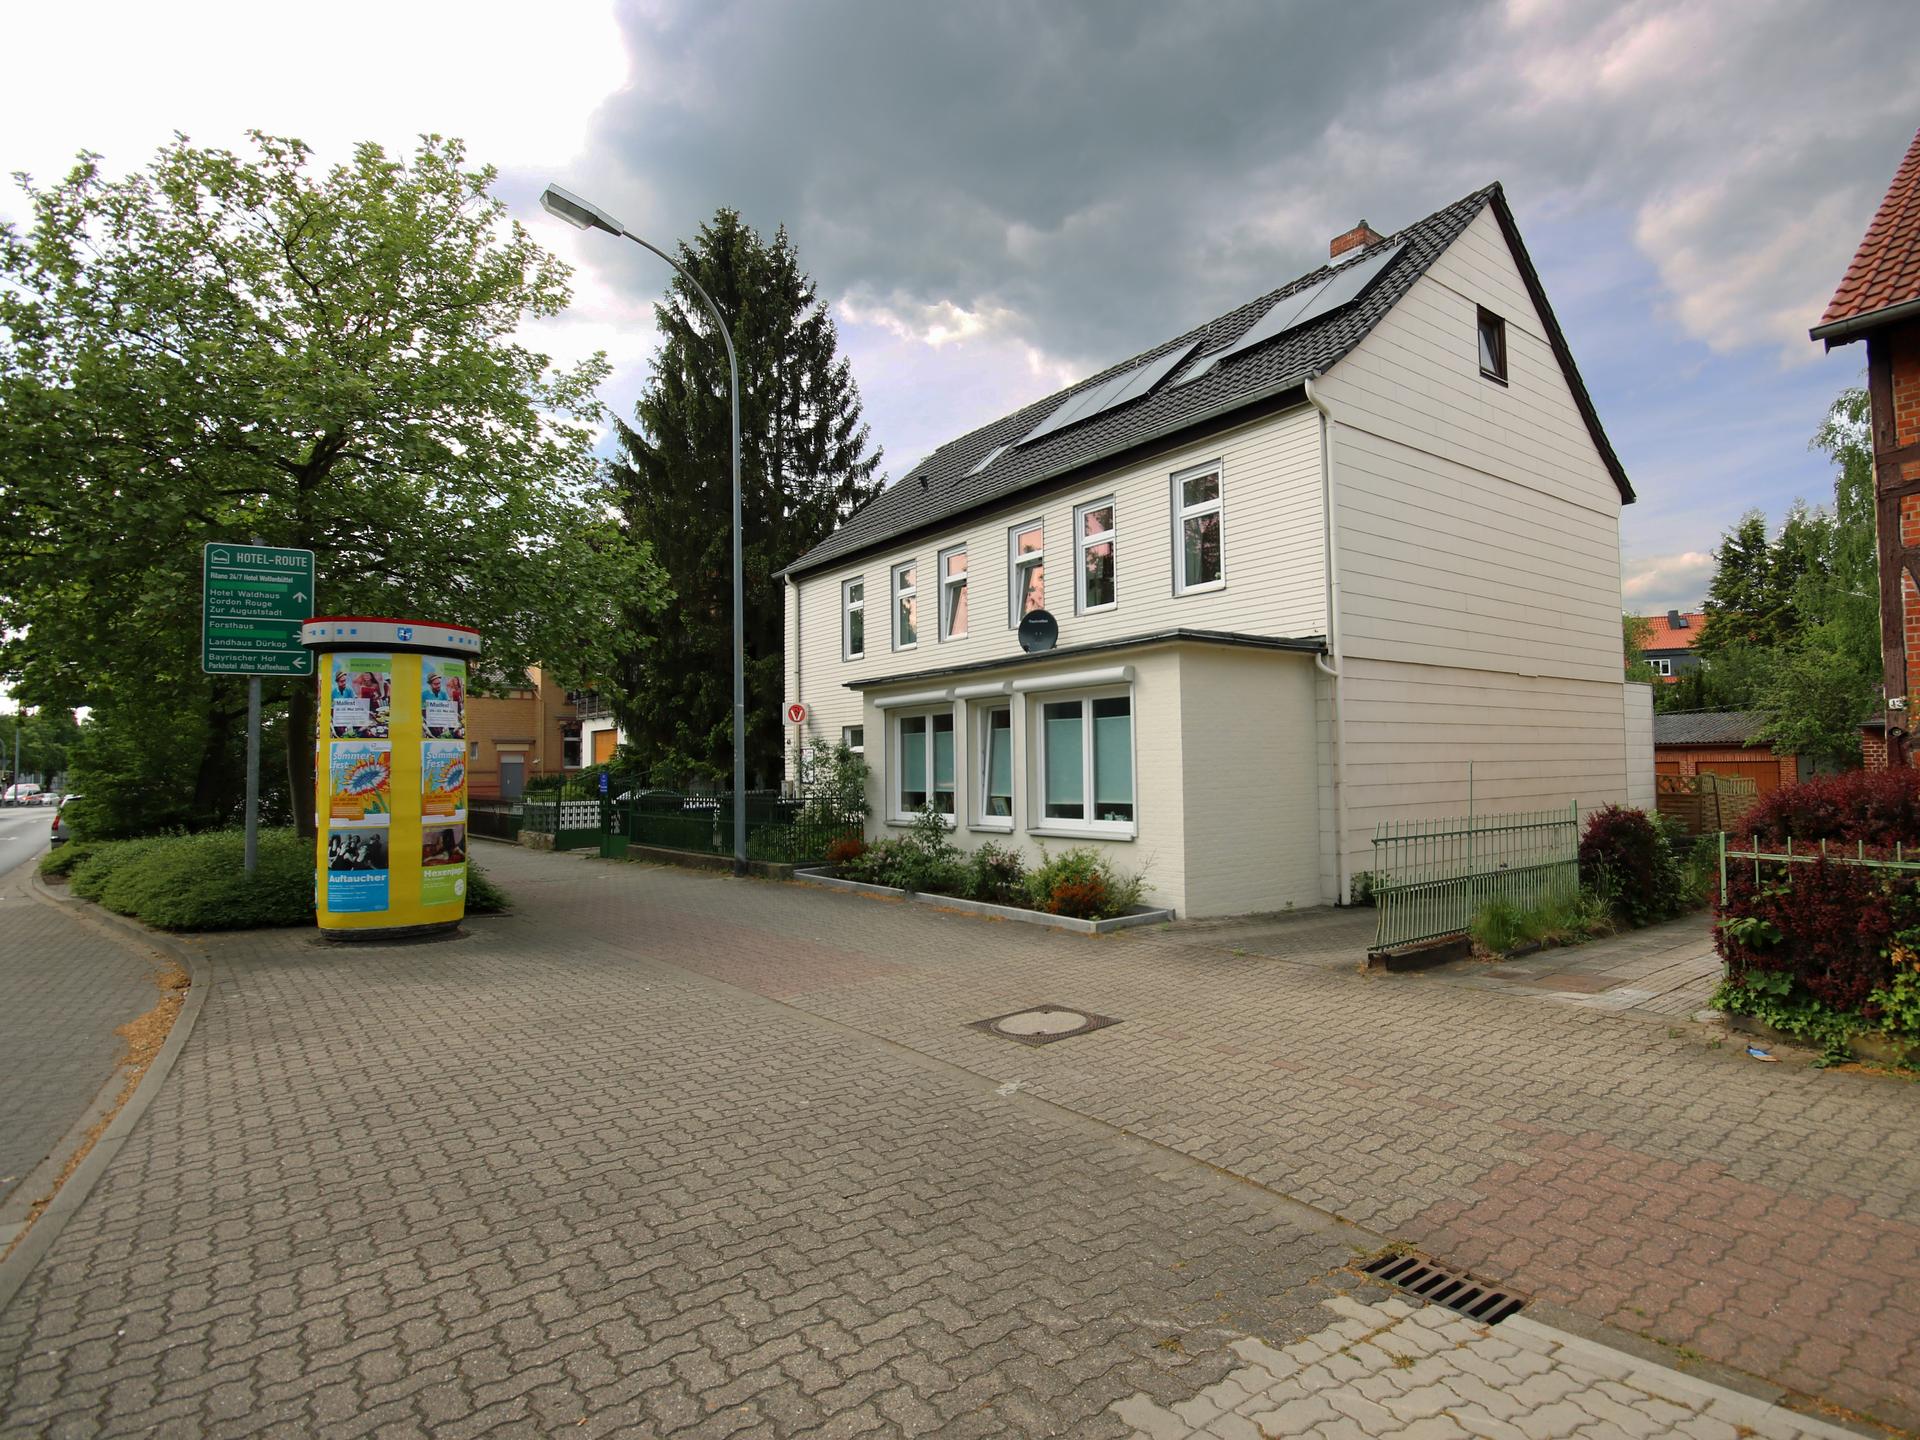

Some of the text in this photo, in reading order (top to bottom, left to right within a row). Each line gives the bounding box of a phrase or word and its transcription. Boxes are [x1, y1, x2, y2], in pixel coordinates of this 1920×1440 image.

[237, 552, 308, 567] HOTEL-ROUTE
[244, 574, 258, 582] Hotel
[209, 589, 280, 599] Hotel Waldhaus
[209, 598, 272, 608] Cordon Rouge
[230, 607, 282, 616] Auguststadt
[209, 621, 254, 629] Forsthaus
[208, 638, 287, 648] Landhaus Dürkop
[208, 653, 257, 662] Bayrischer
[329, 874, 387, 883] Auftaucher
